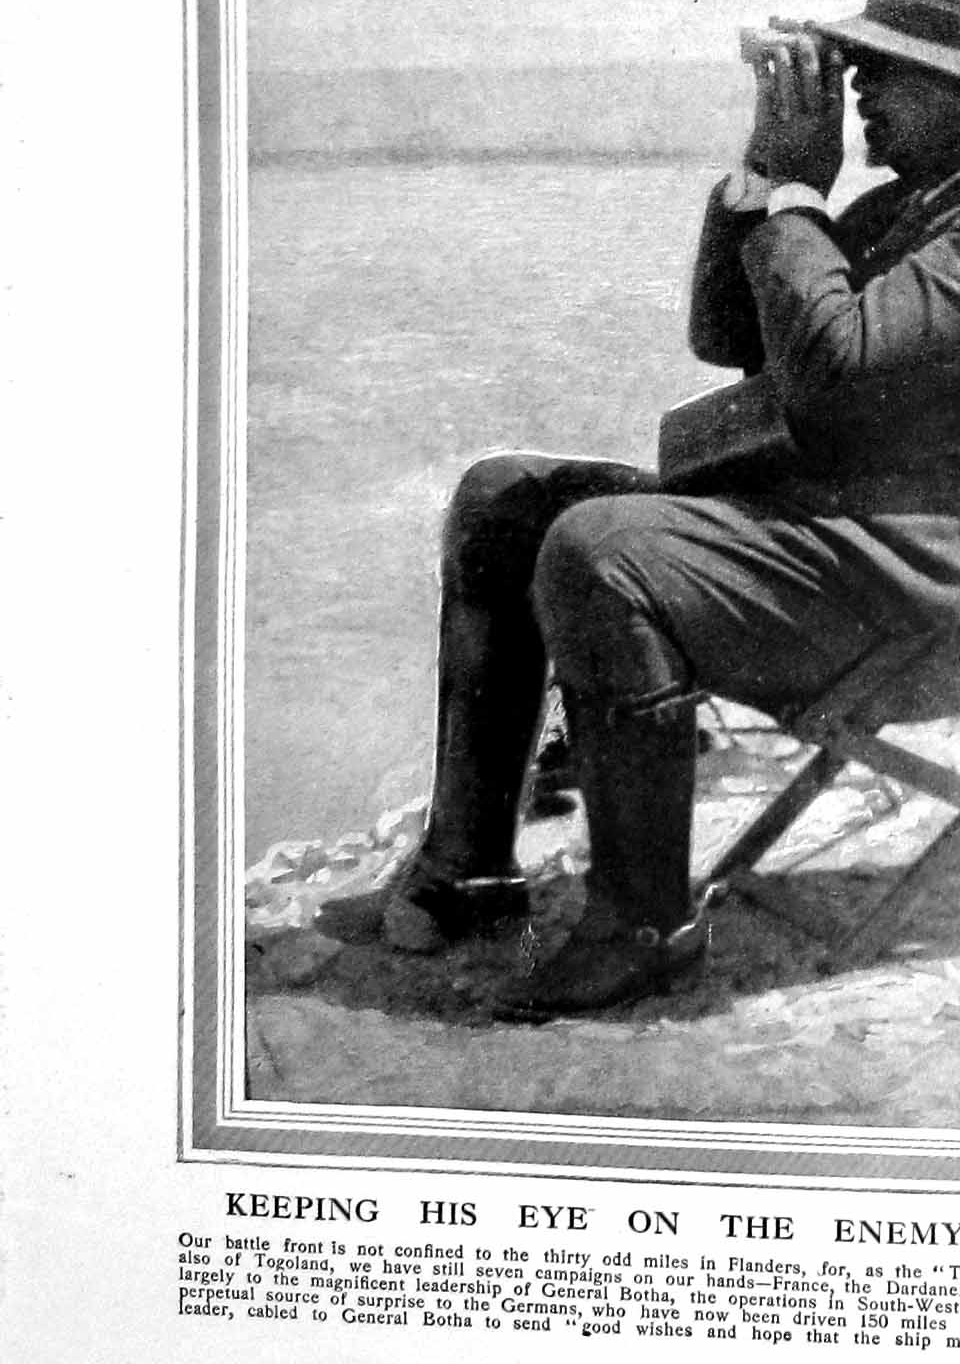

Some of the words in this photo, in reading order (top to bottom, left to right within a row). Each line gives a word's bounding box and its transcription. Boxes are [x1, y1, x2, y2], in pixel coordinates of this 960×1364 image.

[226, 1192, 379, 1223] KEEPING
[420, 1200, 478, 1226] HIS
[519, 1204, 588, 1230] EYE
[628, 1209, 679, 1235] ON
[719, 1214, 794, 1240] THE
[178, 1231, 212, 1249] Our
[225, 1233, 270, 1252] battle
[283, 1236, 324, 1254] front
[331, 1238, 346, 1255] is
[357, 1241, 384, 1257] not
[394, 1243, 464, 1261] confined
[475, 1246, 492, 1262] to
[503, 1247, 529, 1264] the
[543, 1248, 591, 1270] thirty
[602, 1251, 632, 1268] odd
[643, 1253, 689, 1270] miles
[700, 1255, 716, 1272] in
[728, 1256, 808, 1278] Flanders,
[822, 1260, 851, 1280] for,
[865, 1266, 884, 1278] as
[895, 1263, 922, 1280] the
[178, 1248, 211, 1266] also
[224, 1251, 242, 1267] of
[254, 1252, 335, 1274] Togoland,
[349, 1261, 372, 1273] we
[383, 1258, 421, 1276] have
[432, 1261, 464, 1278] still
[476, 1267, 523, 1280] seven
[535, 1267, 622, 1288] campaigns
[633, 1274, 653, 1286] on
[665, 1275, 695, 1288] our
[844, 1278, 871, 1295] the
[179, 1265, 235, 1288] largely
[246, 1269, 262, 1285] to
[273, 1270, 299, 1287] the
[310, 1273, 405, 1293] magnificent
[416, 1276, 502, 1300] leadership
[513, 1281, 531, 1298] of
[541, 1282, 608, 1301] General
[620, 1286, 675, 1306] Botha,
[690, 1289, 716, 1306] the
[728, 1292, 817, 1311] operations
[828, 1294, 844, 1311] in
[857, 1295, 959, 1315] South-West
[179, 1285, 255, 1304] perpetual
[266, 1291, 319, 1305] source
[330, 1290, 348, 1306] of
[357, 1293, 425, 1312] surprise
[436, 1295, 452, 1311] to
[463, 1296, 490, 1313] the
[501, 1297, 583, 1319] Germans,
[591, 1302, 626, 1319] who
[640, 1303, 680, 1321] have
[694, 1310, 729, 1323] now
[742, 1308, 780, 1325] been
[792, 1310, 847, 1328] driven
[861, 1312, 889, 1330] 150
[901, 1314, 947, 1332] miles
